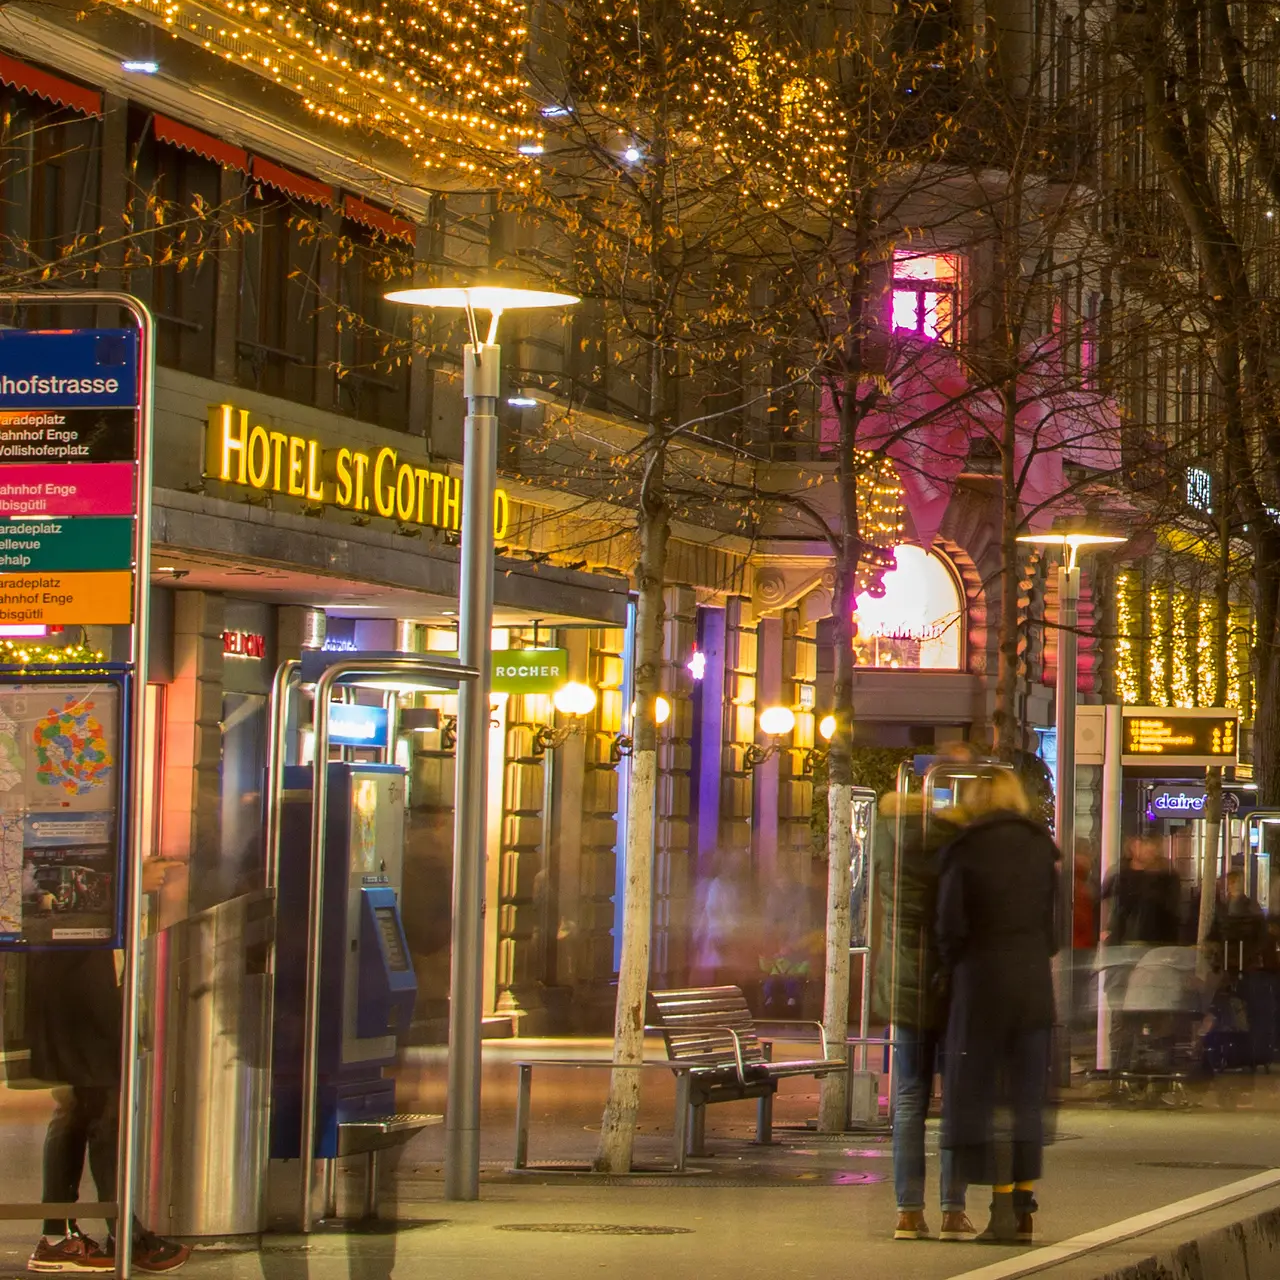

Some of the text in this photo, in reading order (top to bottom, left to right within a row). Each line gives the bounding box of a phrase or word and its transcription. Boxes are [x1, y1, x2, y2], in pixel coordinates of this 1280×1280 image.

[0, 376, 119, 394] hofstrasse
[0, 413, 66, 427] aradeplatz
[0, 429, 78, 442] ahnhof Enge
[220, 404, 509, 541] HOTEL ST. GOTTHD
[45, 483, 77, 498] Enge
[42, 593, 73, 606] Enge
[495, 666, 560, 678] ROCHER
